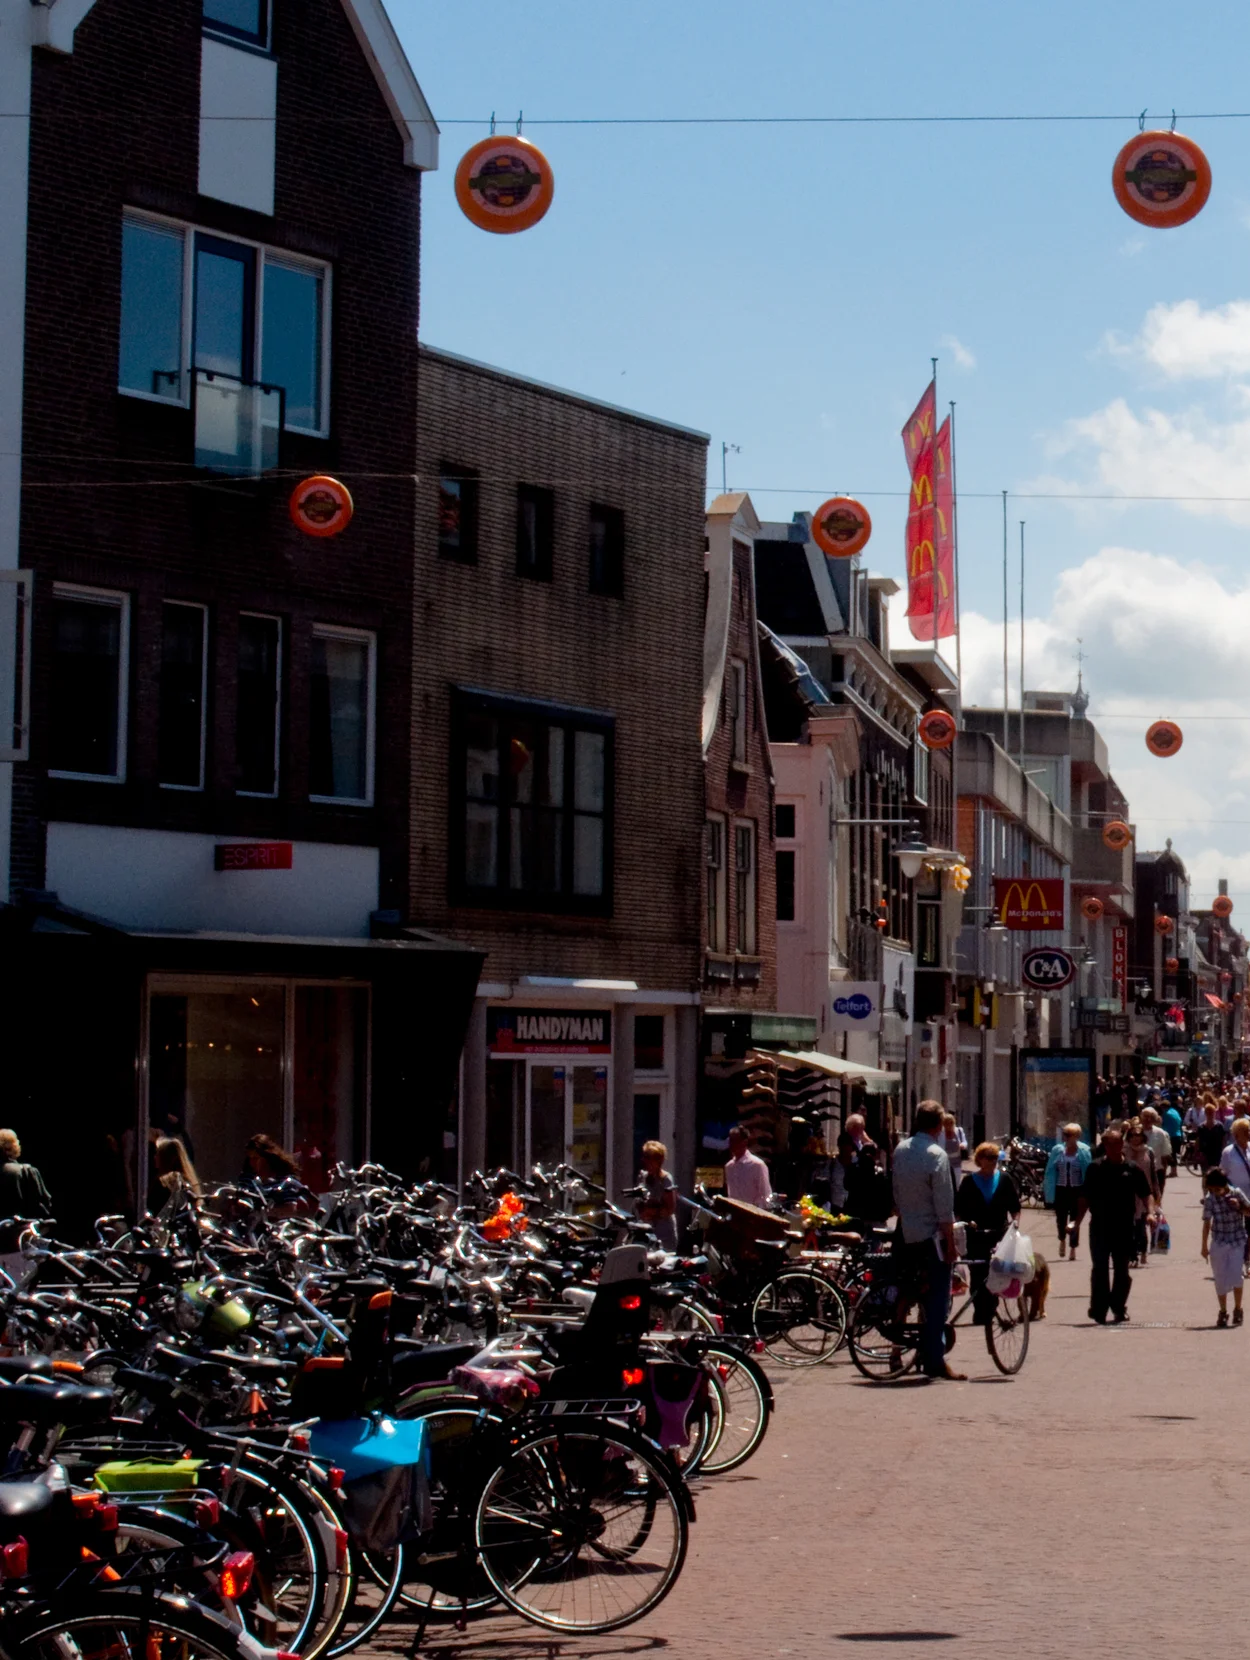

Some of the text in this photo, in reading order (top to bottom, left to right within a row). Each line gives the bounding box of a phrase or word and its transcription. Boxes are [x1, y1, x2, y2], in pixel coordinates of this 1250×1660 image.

[224, 847, 279, 867] ESPRIT
[1008, 909, 1063, 917] McDonald's
[1029, 958, 1066, 978] C&A
[836, 1000, 870, 1012] Telfort
[516, 1014, 604, 1041] HANDYMAN
